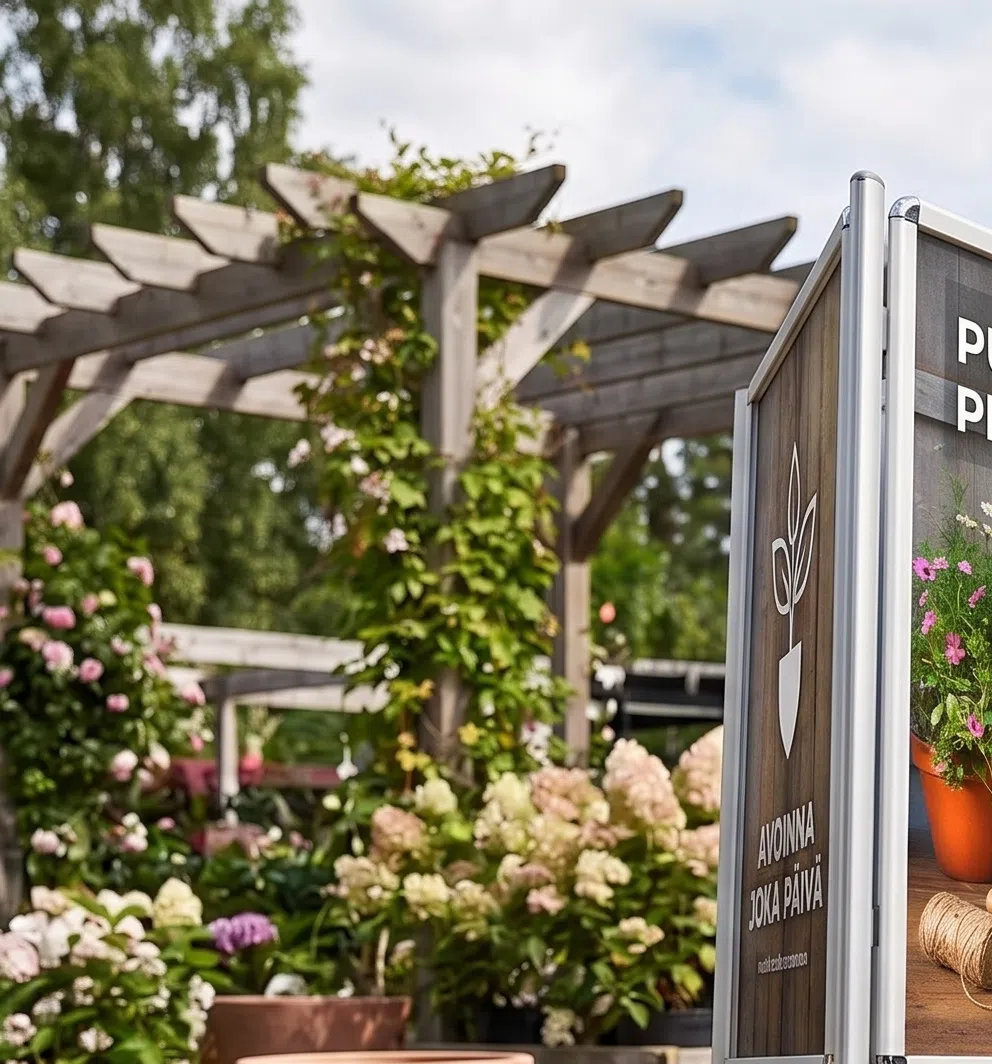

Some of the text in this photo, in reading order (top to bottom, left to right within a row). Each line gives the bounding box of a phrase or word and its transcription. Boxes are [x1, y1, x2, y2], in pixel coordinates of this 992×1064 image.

[757, 801, 815, 869] AVOINNA
[748, 854, 823, 932] JOKA PÄIVÄ
